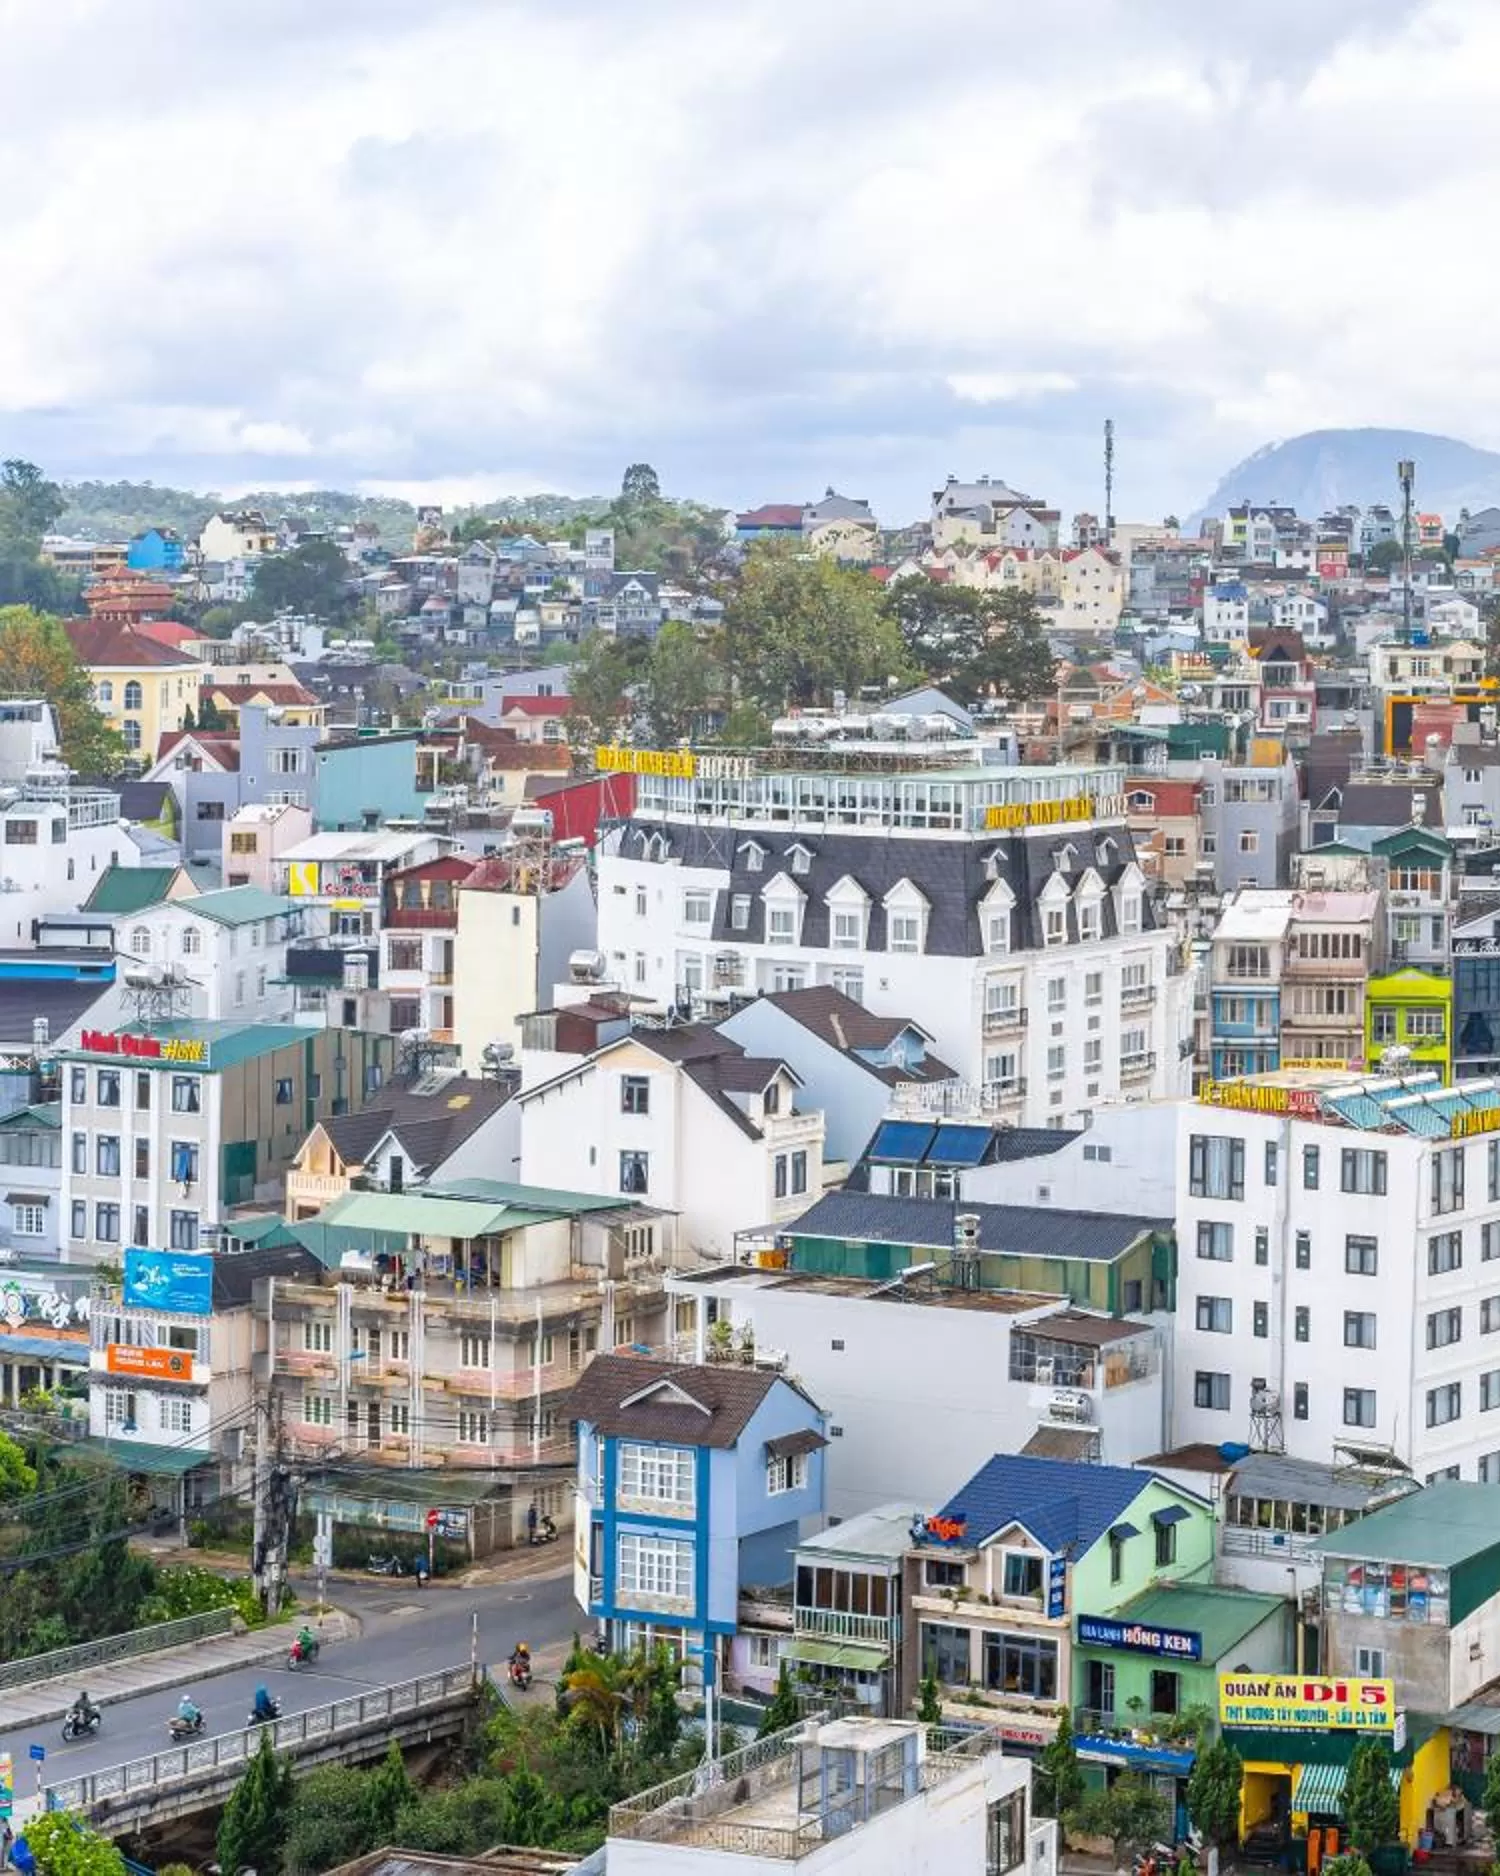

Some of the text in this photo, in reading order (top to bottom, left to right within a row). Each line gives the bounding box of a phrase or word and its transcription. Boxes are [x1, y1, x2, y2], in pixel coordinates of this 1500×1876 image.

[927, 1515, 968, 1541] Tiger
[1164, 1633, 1192, 1653] KEN
[1225, 1682, 1270, 1697] QUÁN
[1275, 1681, 1297, 1699] ĂN
[1360, 1685, 1386, 1705] 5
